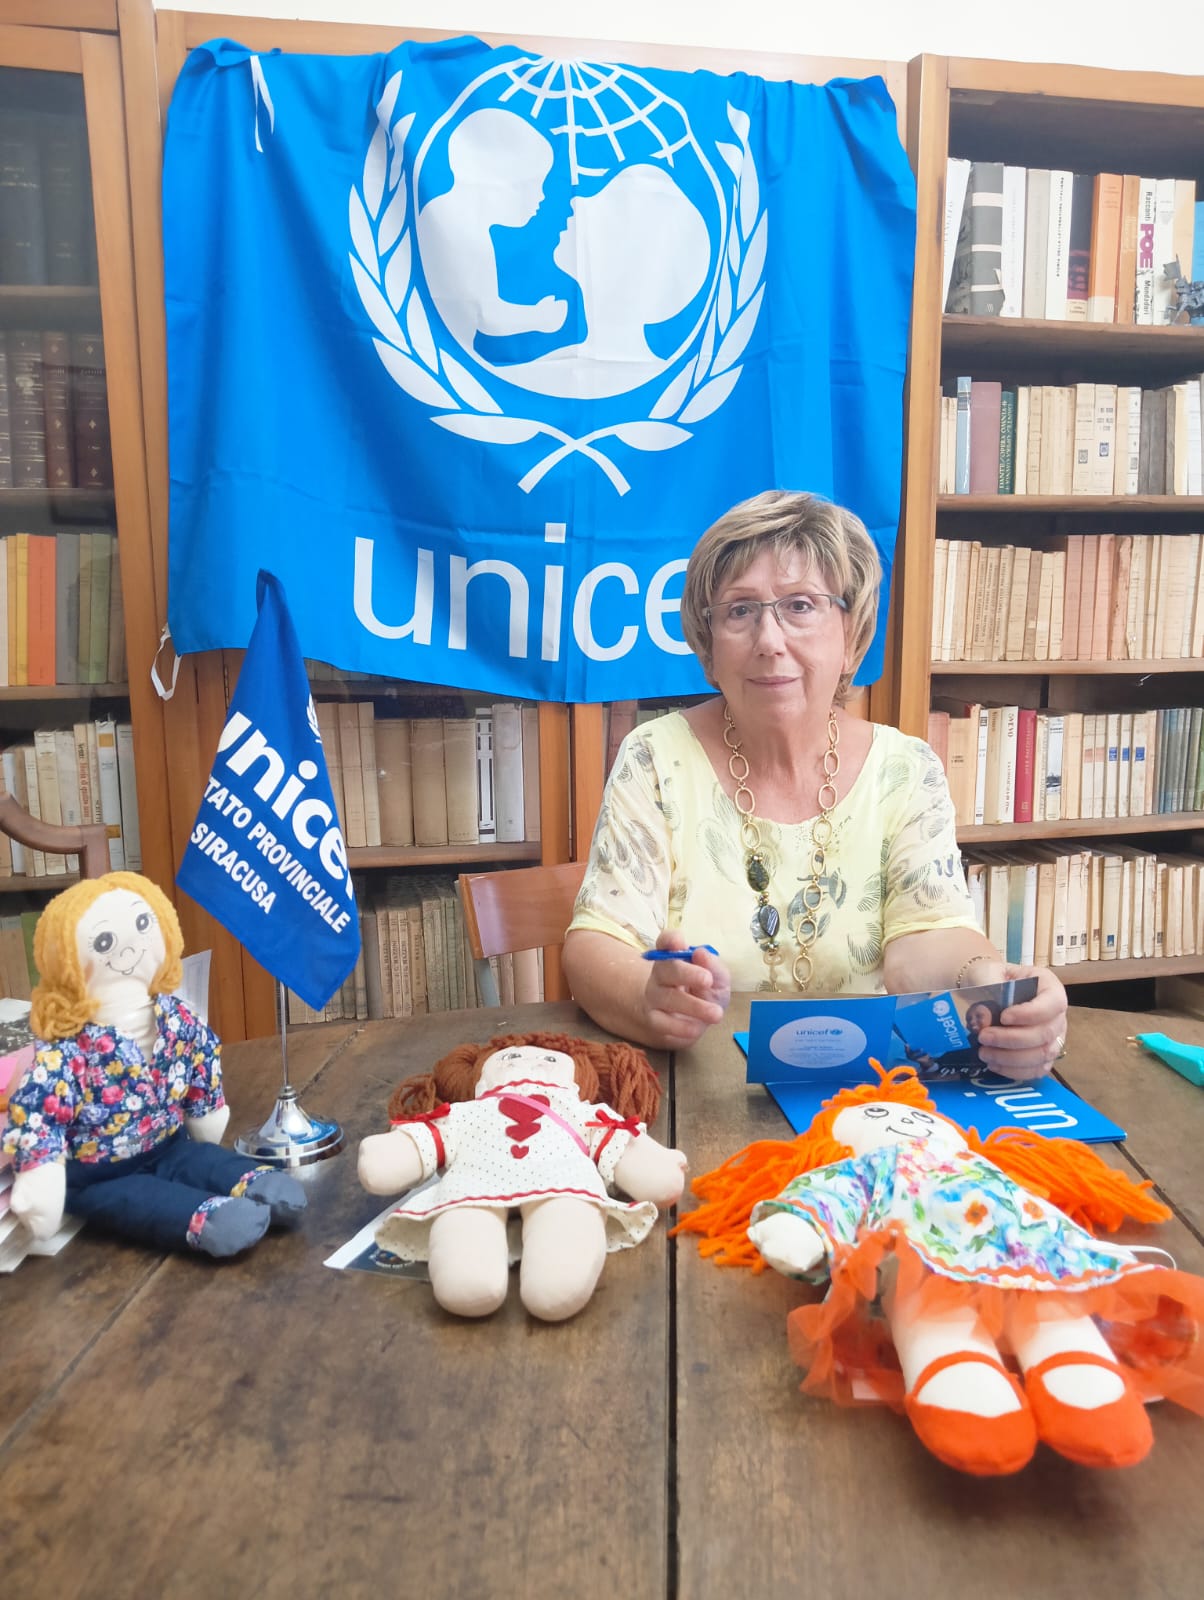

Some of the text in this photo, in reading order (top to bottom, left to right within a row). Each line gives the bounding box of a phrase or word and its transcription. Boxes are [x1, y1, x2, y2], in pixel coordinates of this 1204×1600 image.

[1140, 191, 1155, 316] Racconti POE Mondadori
[353, 522, 698, 662] unice
[217, 711, 353, 901] nice
[190, 822, 277, 914] SIRACUSA
[247, 821, 351, 934] PROVINCIALE
[796, 1028, 829, 1036] unicef
[936, 1015, 964, 1048] unicef
